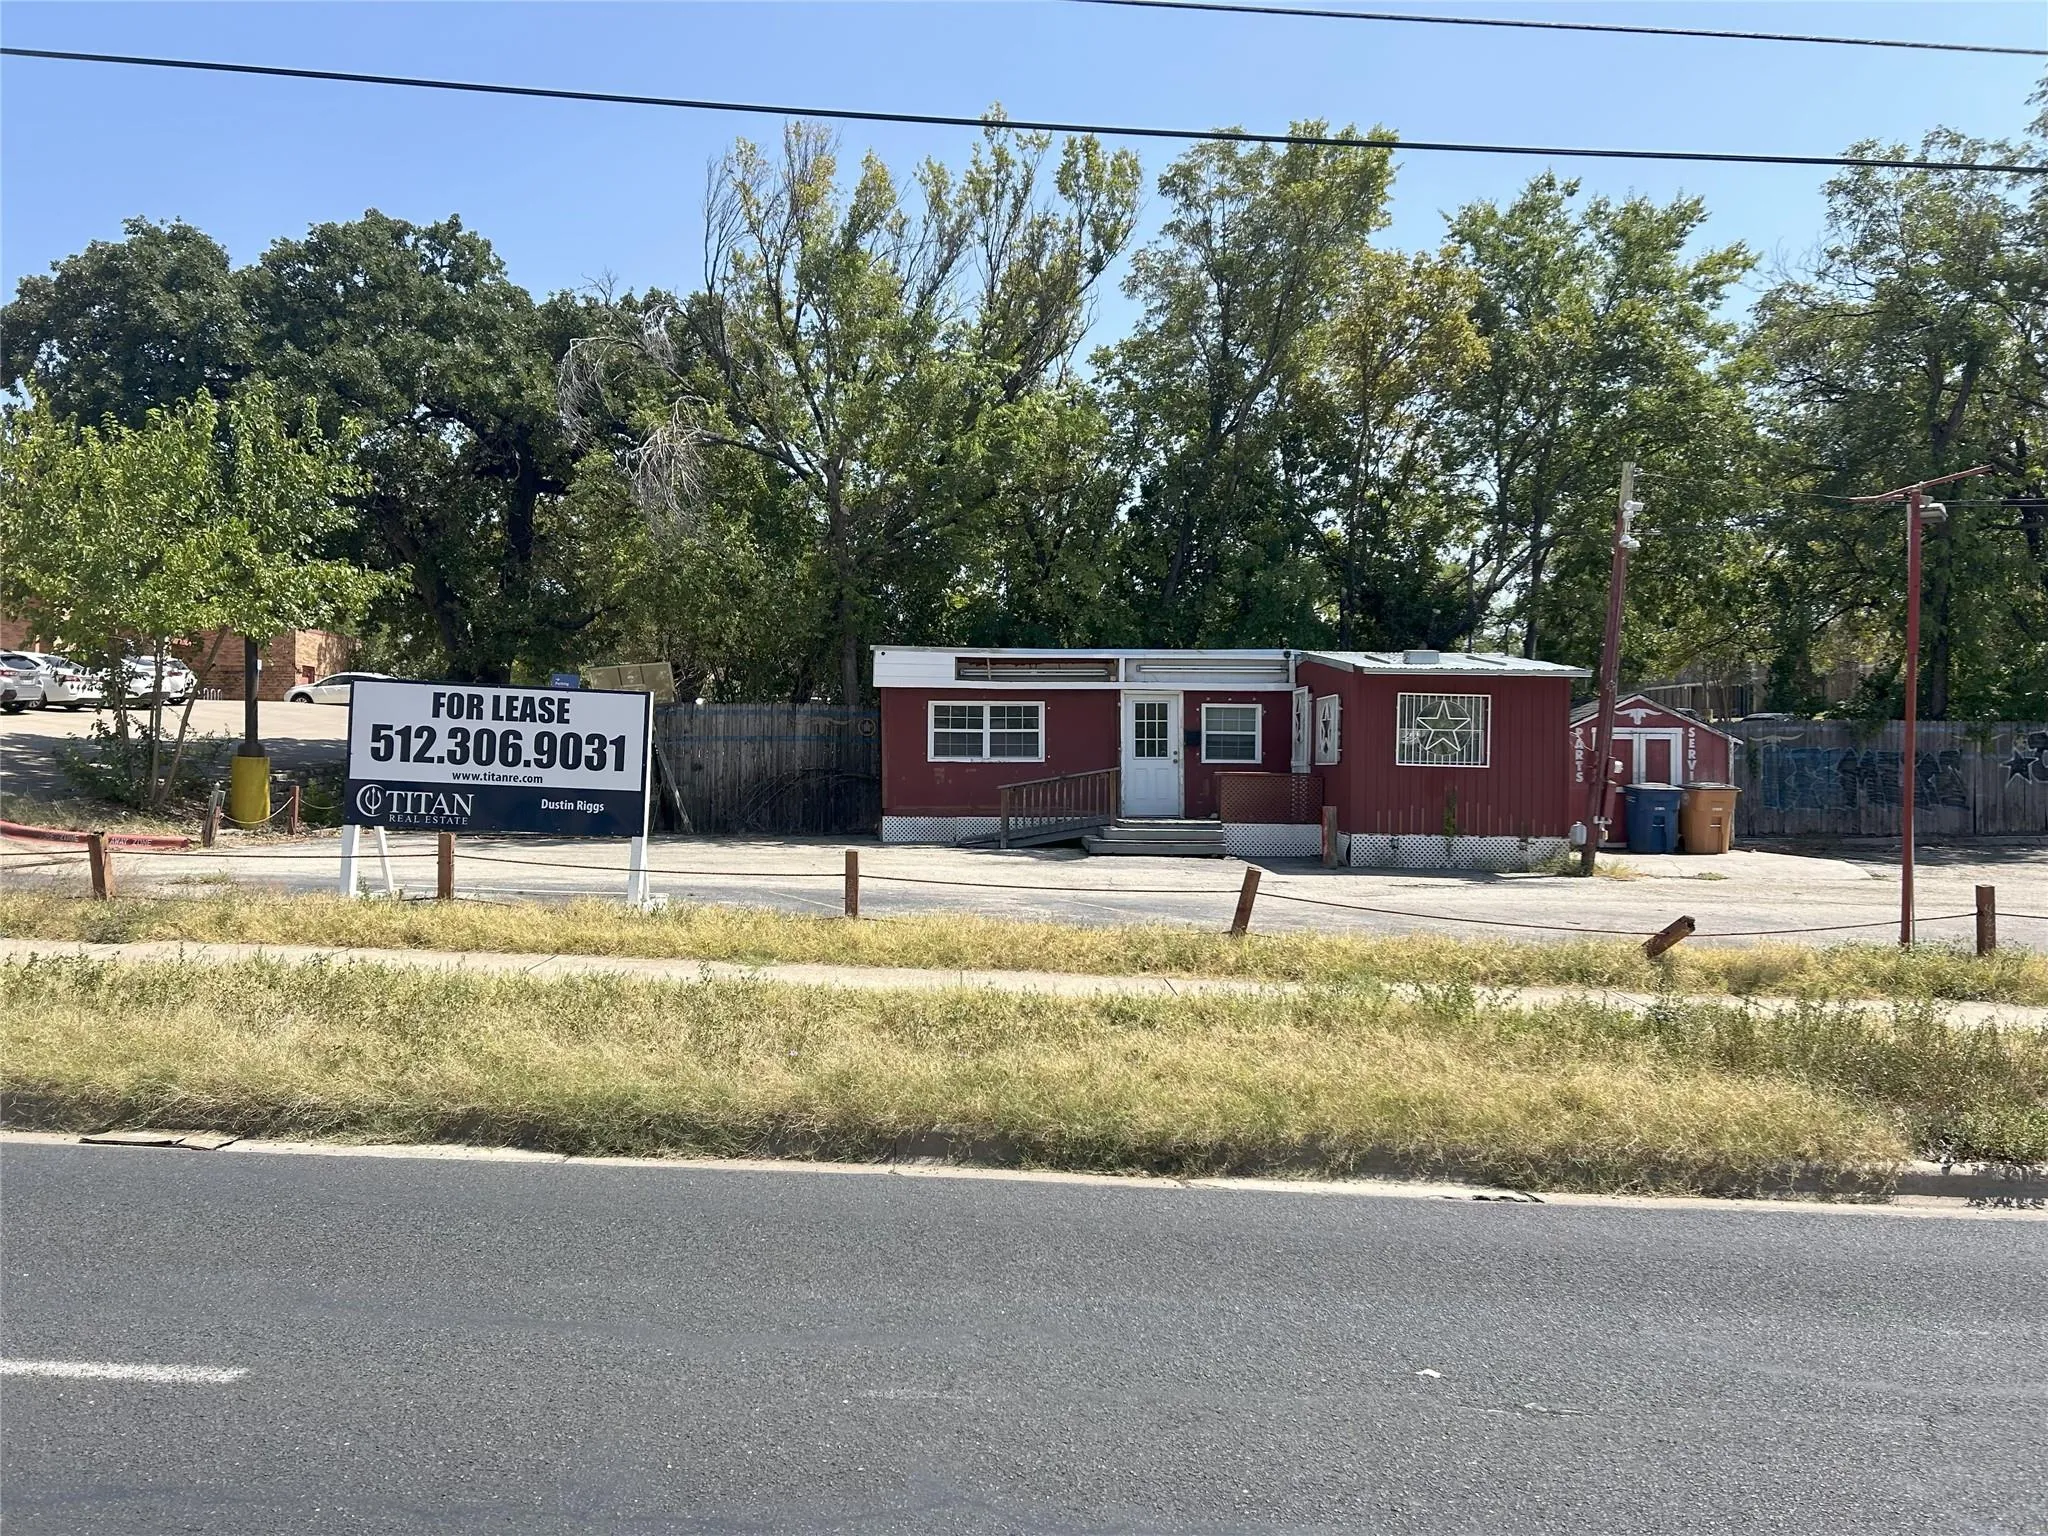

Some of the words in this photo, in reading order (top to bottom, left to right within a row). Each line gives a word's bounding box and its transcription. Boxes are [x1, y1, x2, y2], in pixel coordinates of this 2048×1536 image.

[432, 692, 484, 720] FOR
[492, 695, 570, 724] LEASE
[370, 724, 626, 772] 512.306.9031
[1574, 727, 1585, 782] PARTS
[1687, 727, 1697, 781] SERVI
[452, 771, 543, 784] www.titanre.com
[385, 790, 475, 816] TITAN
[541, 798, 574, 810] Dustin
[577, 800, 605, 814] Riggs
[389, 814, 420, 824] REAL
[425, 815, 468, 825] ESTATE
